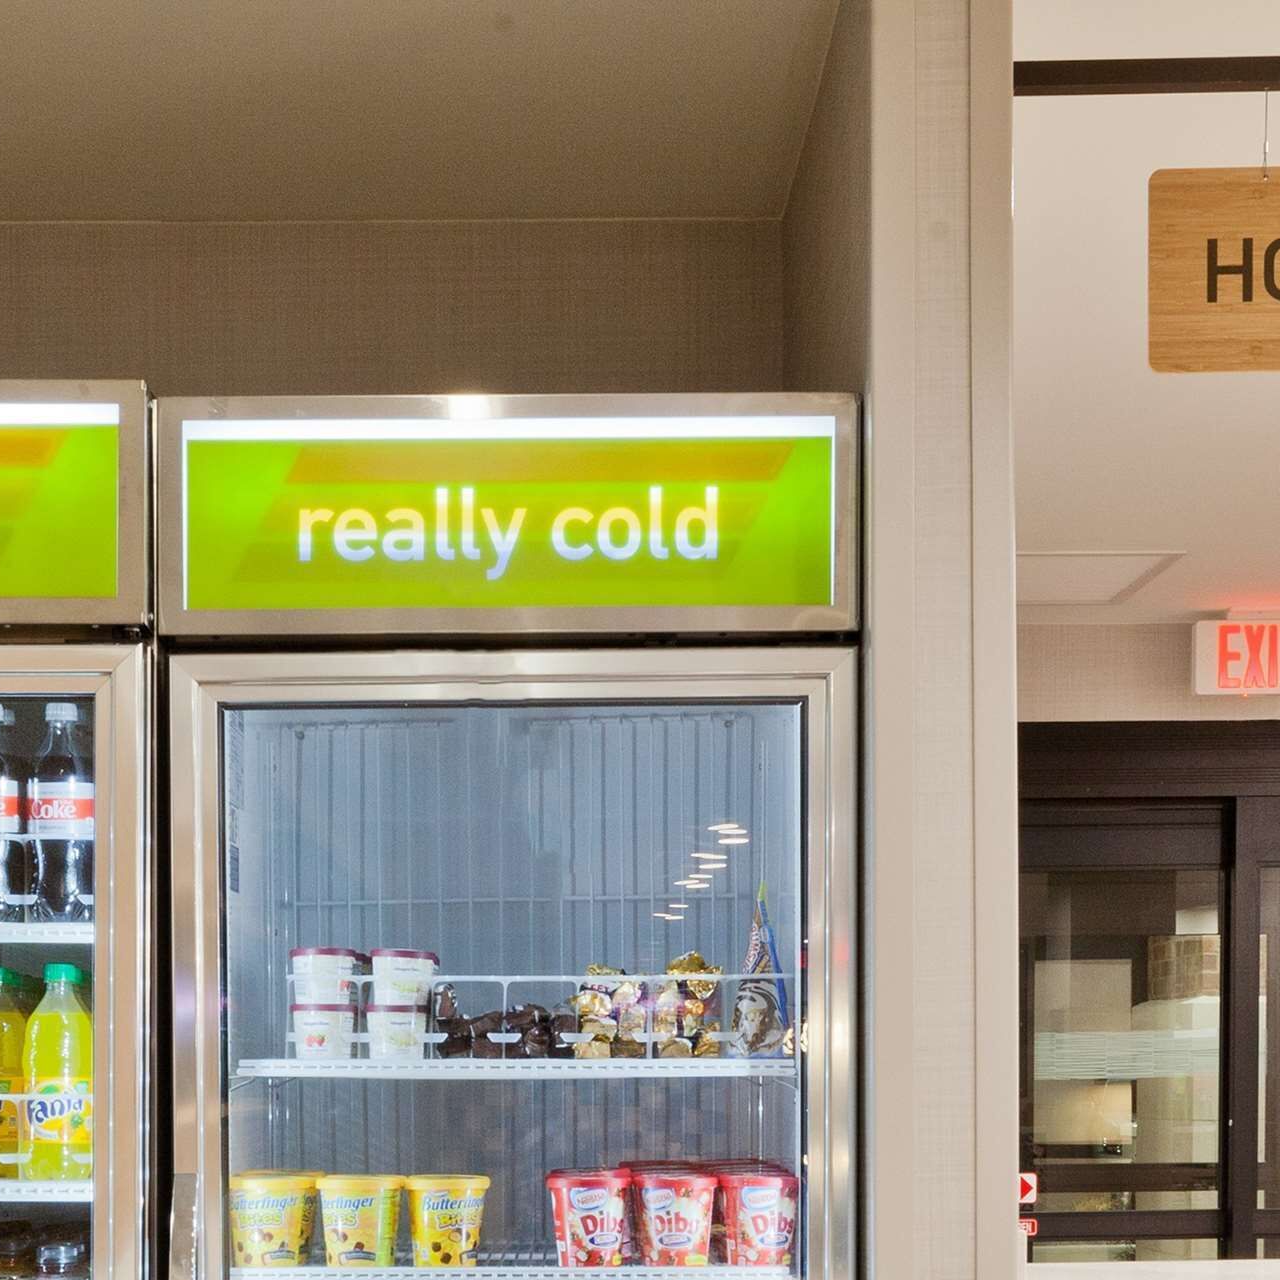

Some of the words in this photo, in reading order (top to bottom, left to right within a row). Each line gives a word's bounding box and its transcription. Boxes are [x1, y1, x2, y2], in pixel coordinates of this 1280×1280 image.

[298, 487, 527, 580] really
[551, 485, 718, 560] cold
[31, 797, 76, 819] Coke
[580, 1211, 624, 1236] Dibs
[751, 1212, 794, 1236] Dibs
